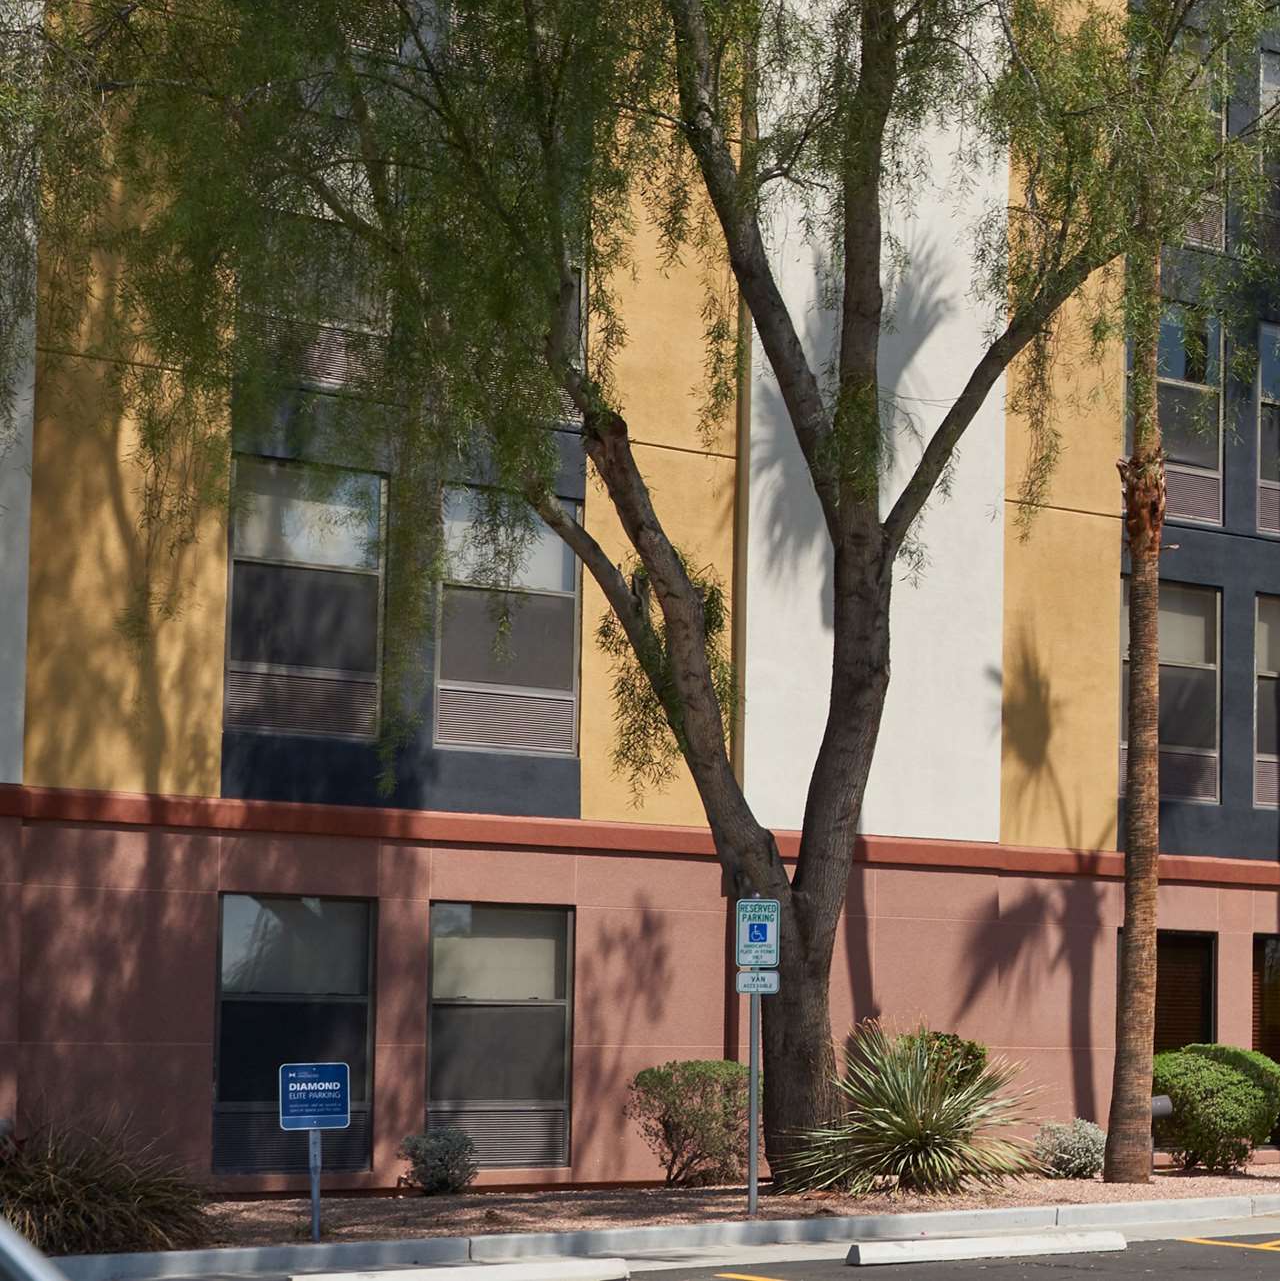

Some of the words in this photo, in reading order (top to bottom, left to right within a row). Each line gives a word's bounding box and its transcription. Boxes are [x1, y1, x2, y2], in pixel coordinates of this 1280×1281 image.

[740, 904, 776, 913] RESERVED
[742, 913, 775, 922] PARKING
[289, 1082, 341, 1091] DIAMOND
[309, 1091, 341, 1099] PARKING
